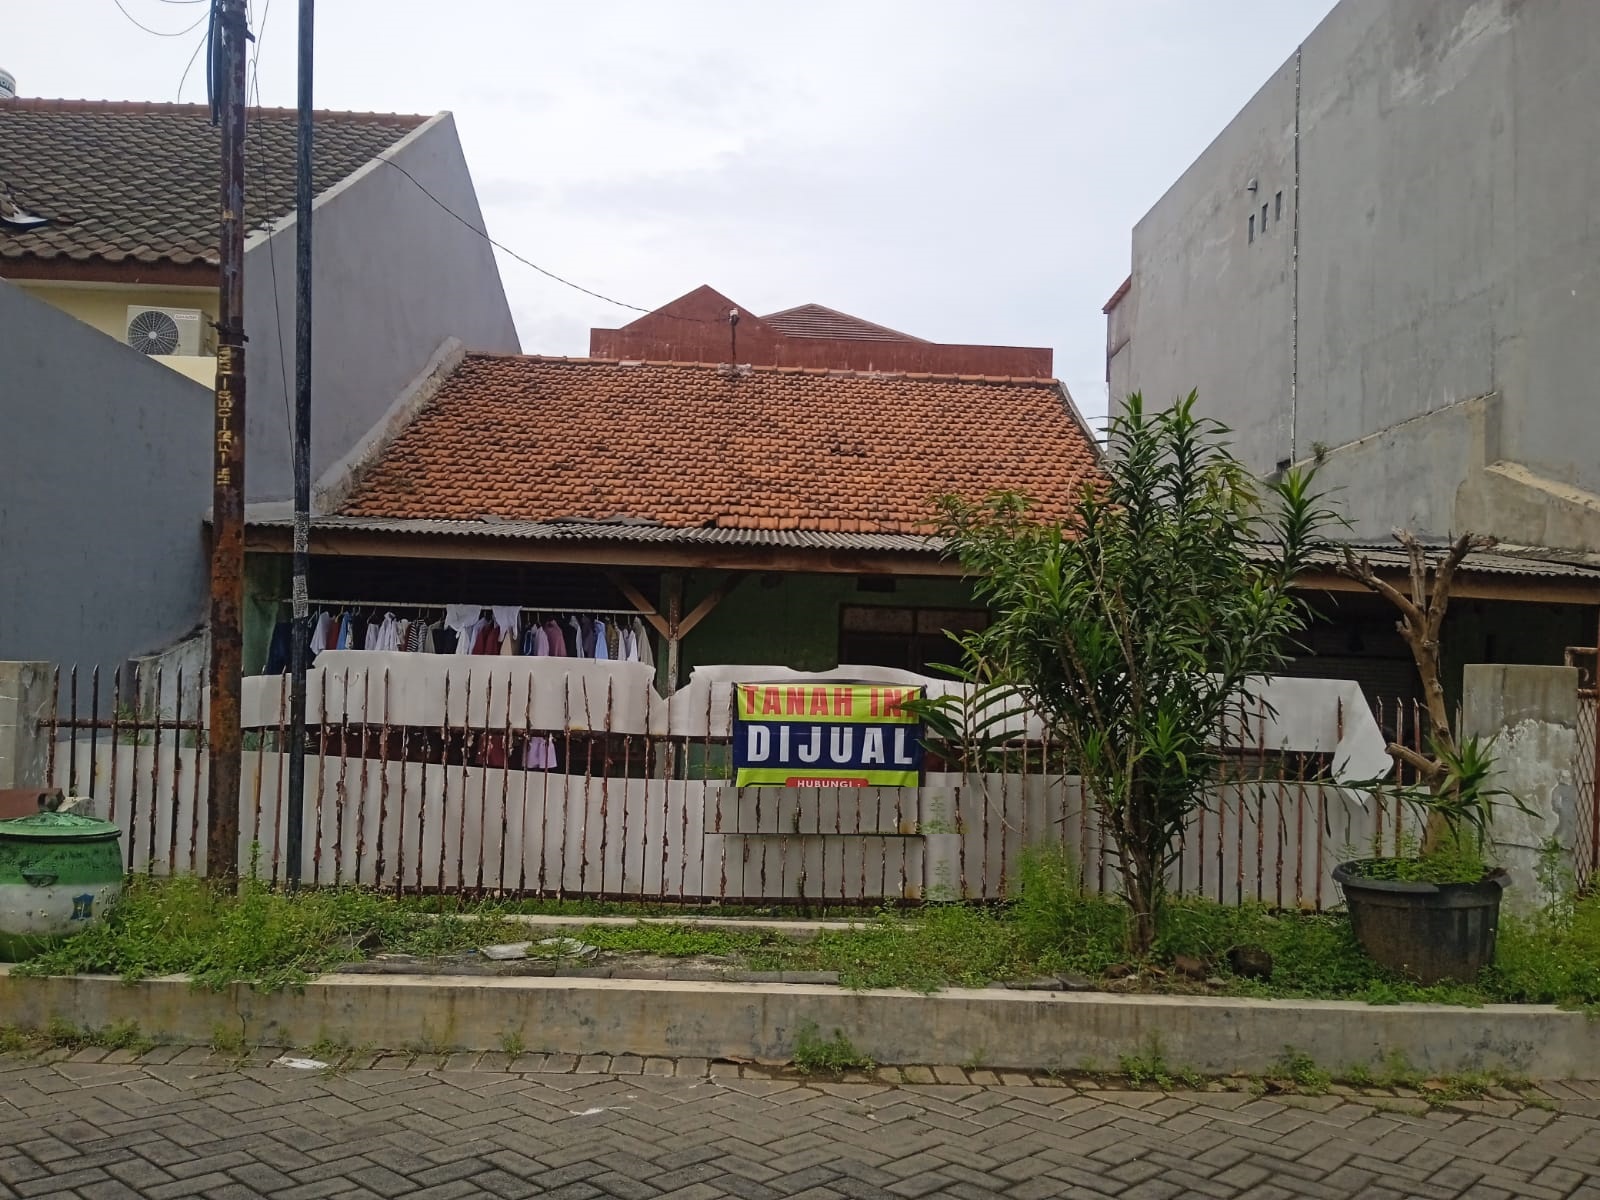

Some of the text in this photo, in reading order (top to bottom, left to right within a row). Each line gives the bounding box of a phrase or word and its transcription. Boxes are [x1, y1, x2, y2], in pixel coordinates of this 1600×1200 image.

[743, 685, 915, 718] TANAH INI
[747, 724, 913, 765] DIJUAL
[797, 779, 853, 788] HUBUNGI
